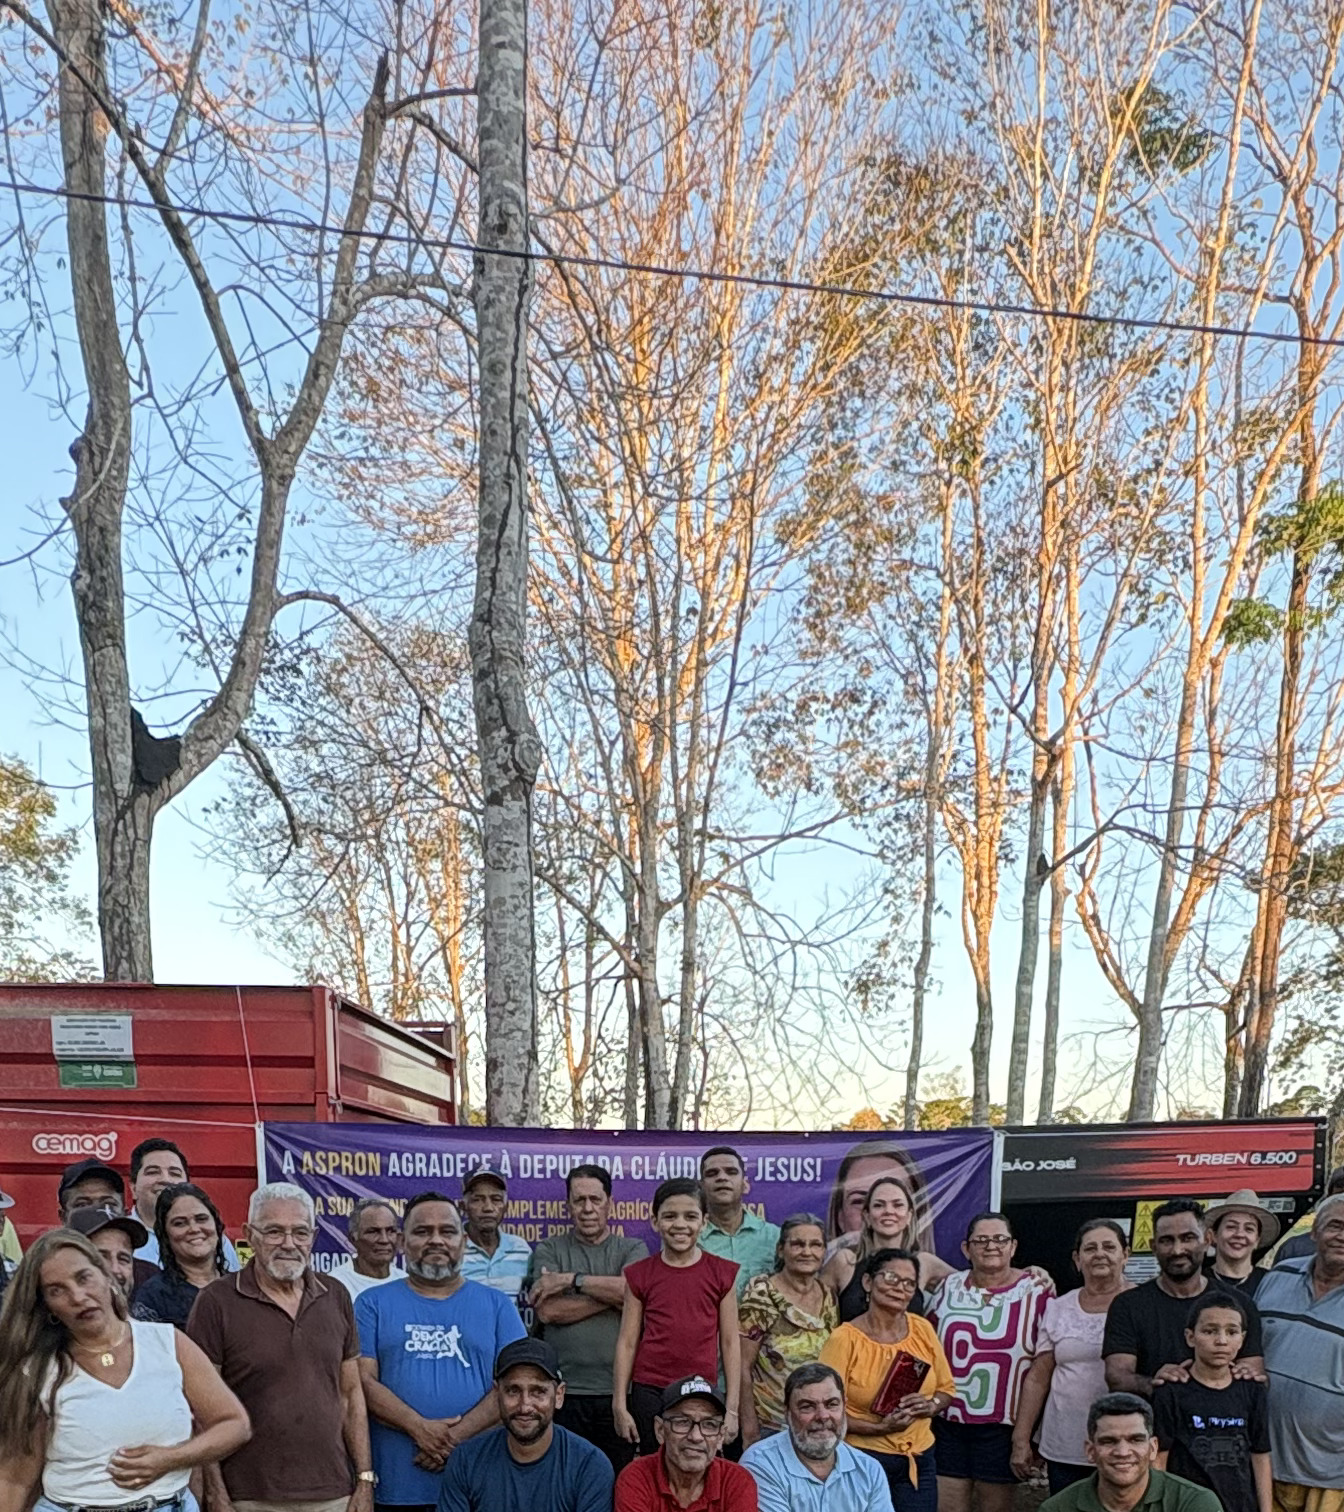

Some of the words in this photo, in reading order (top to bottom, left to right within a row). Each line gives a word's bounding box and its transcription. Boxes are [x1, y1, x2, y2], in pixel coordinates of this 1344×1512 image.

[33, 1133, 117, 1160] cemag
[282, 1150, 296, 1174] A
[301, 1151, 381, 1176] ASPRON
[500, 1149, 514, 1179] À
[630, 1151, 702, 1180] CLÁUDI
[754, 1157, 822, 1183] JESUS!
[1036, 1157, 1077, 1170] JOSÉ
[1176, 1152, 1249, 1167] TURBEN
[1250, 1151, 1297, 1165] 6.500
